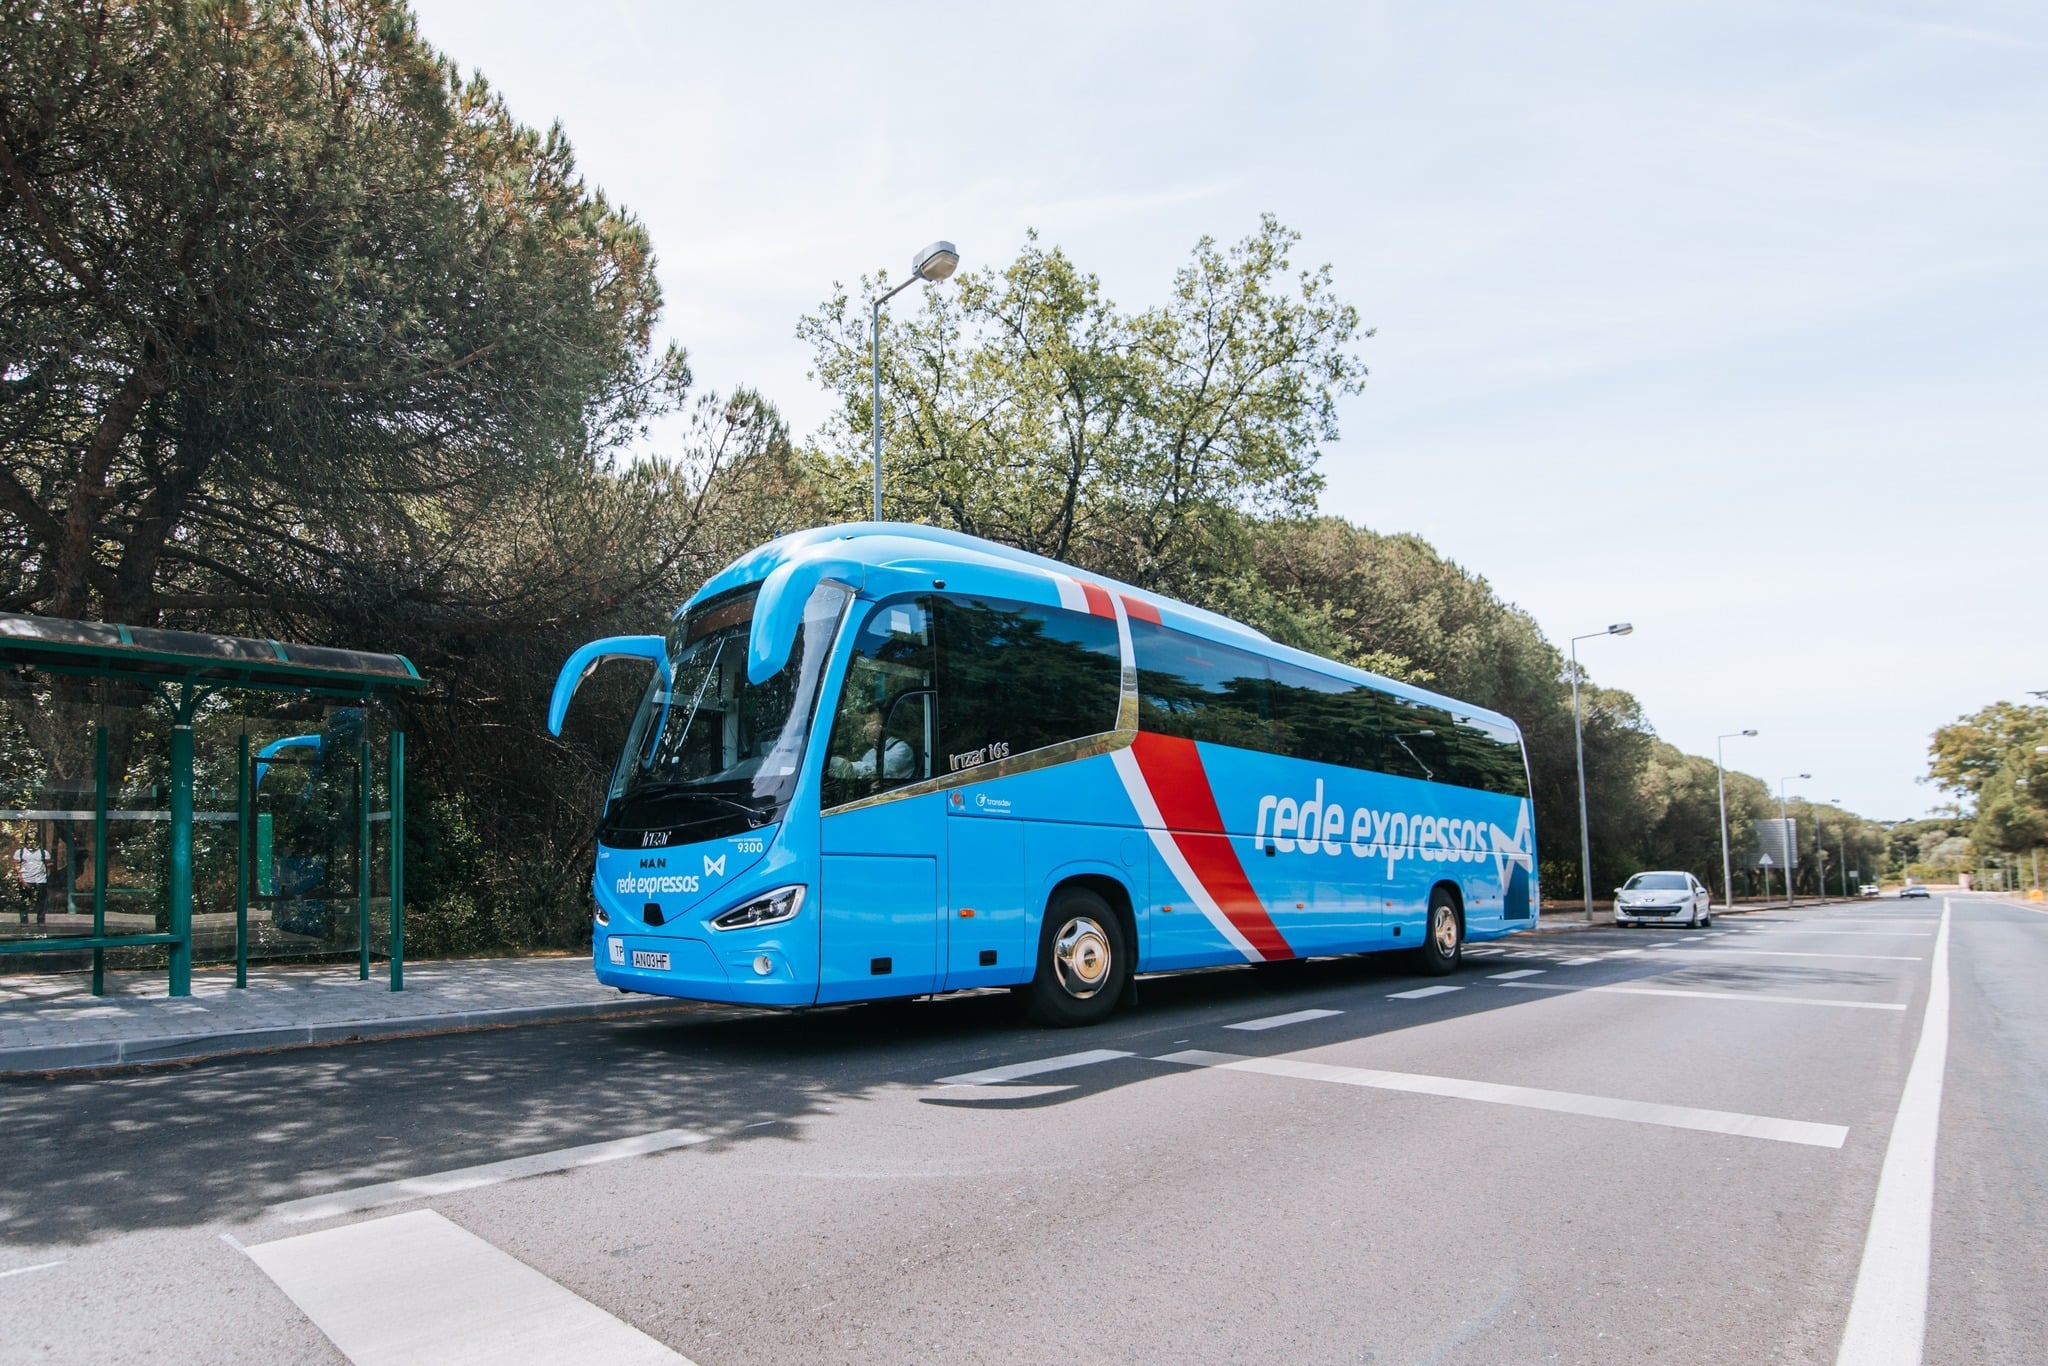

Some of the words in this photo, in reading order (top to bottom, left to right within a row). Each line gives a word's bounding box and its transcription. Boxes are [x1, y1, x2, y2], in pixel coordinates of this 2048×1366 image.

[949, 748, 986, 771] Irizar
[1255, 778, 1344, 856] rede
[1350, 807, 1487, 880] expressos
[737, 842, 763, 853] 9300
[640, 858, 666, 868] MAN
[616, 871, 636, 893] rede
[637, 875, 699, 899] expressos
